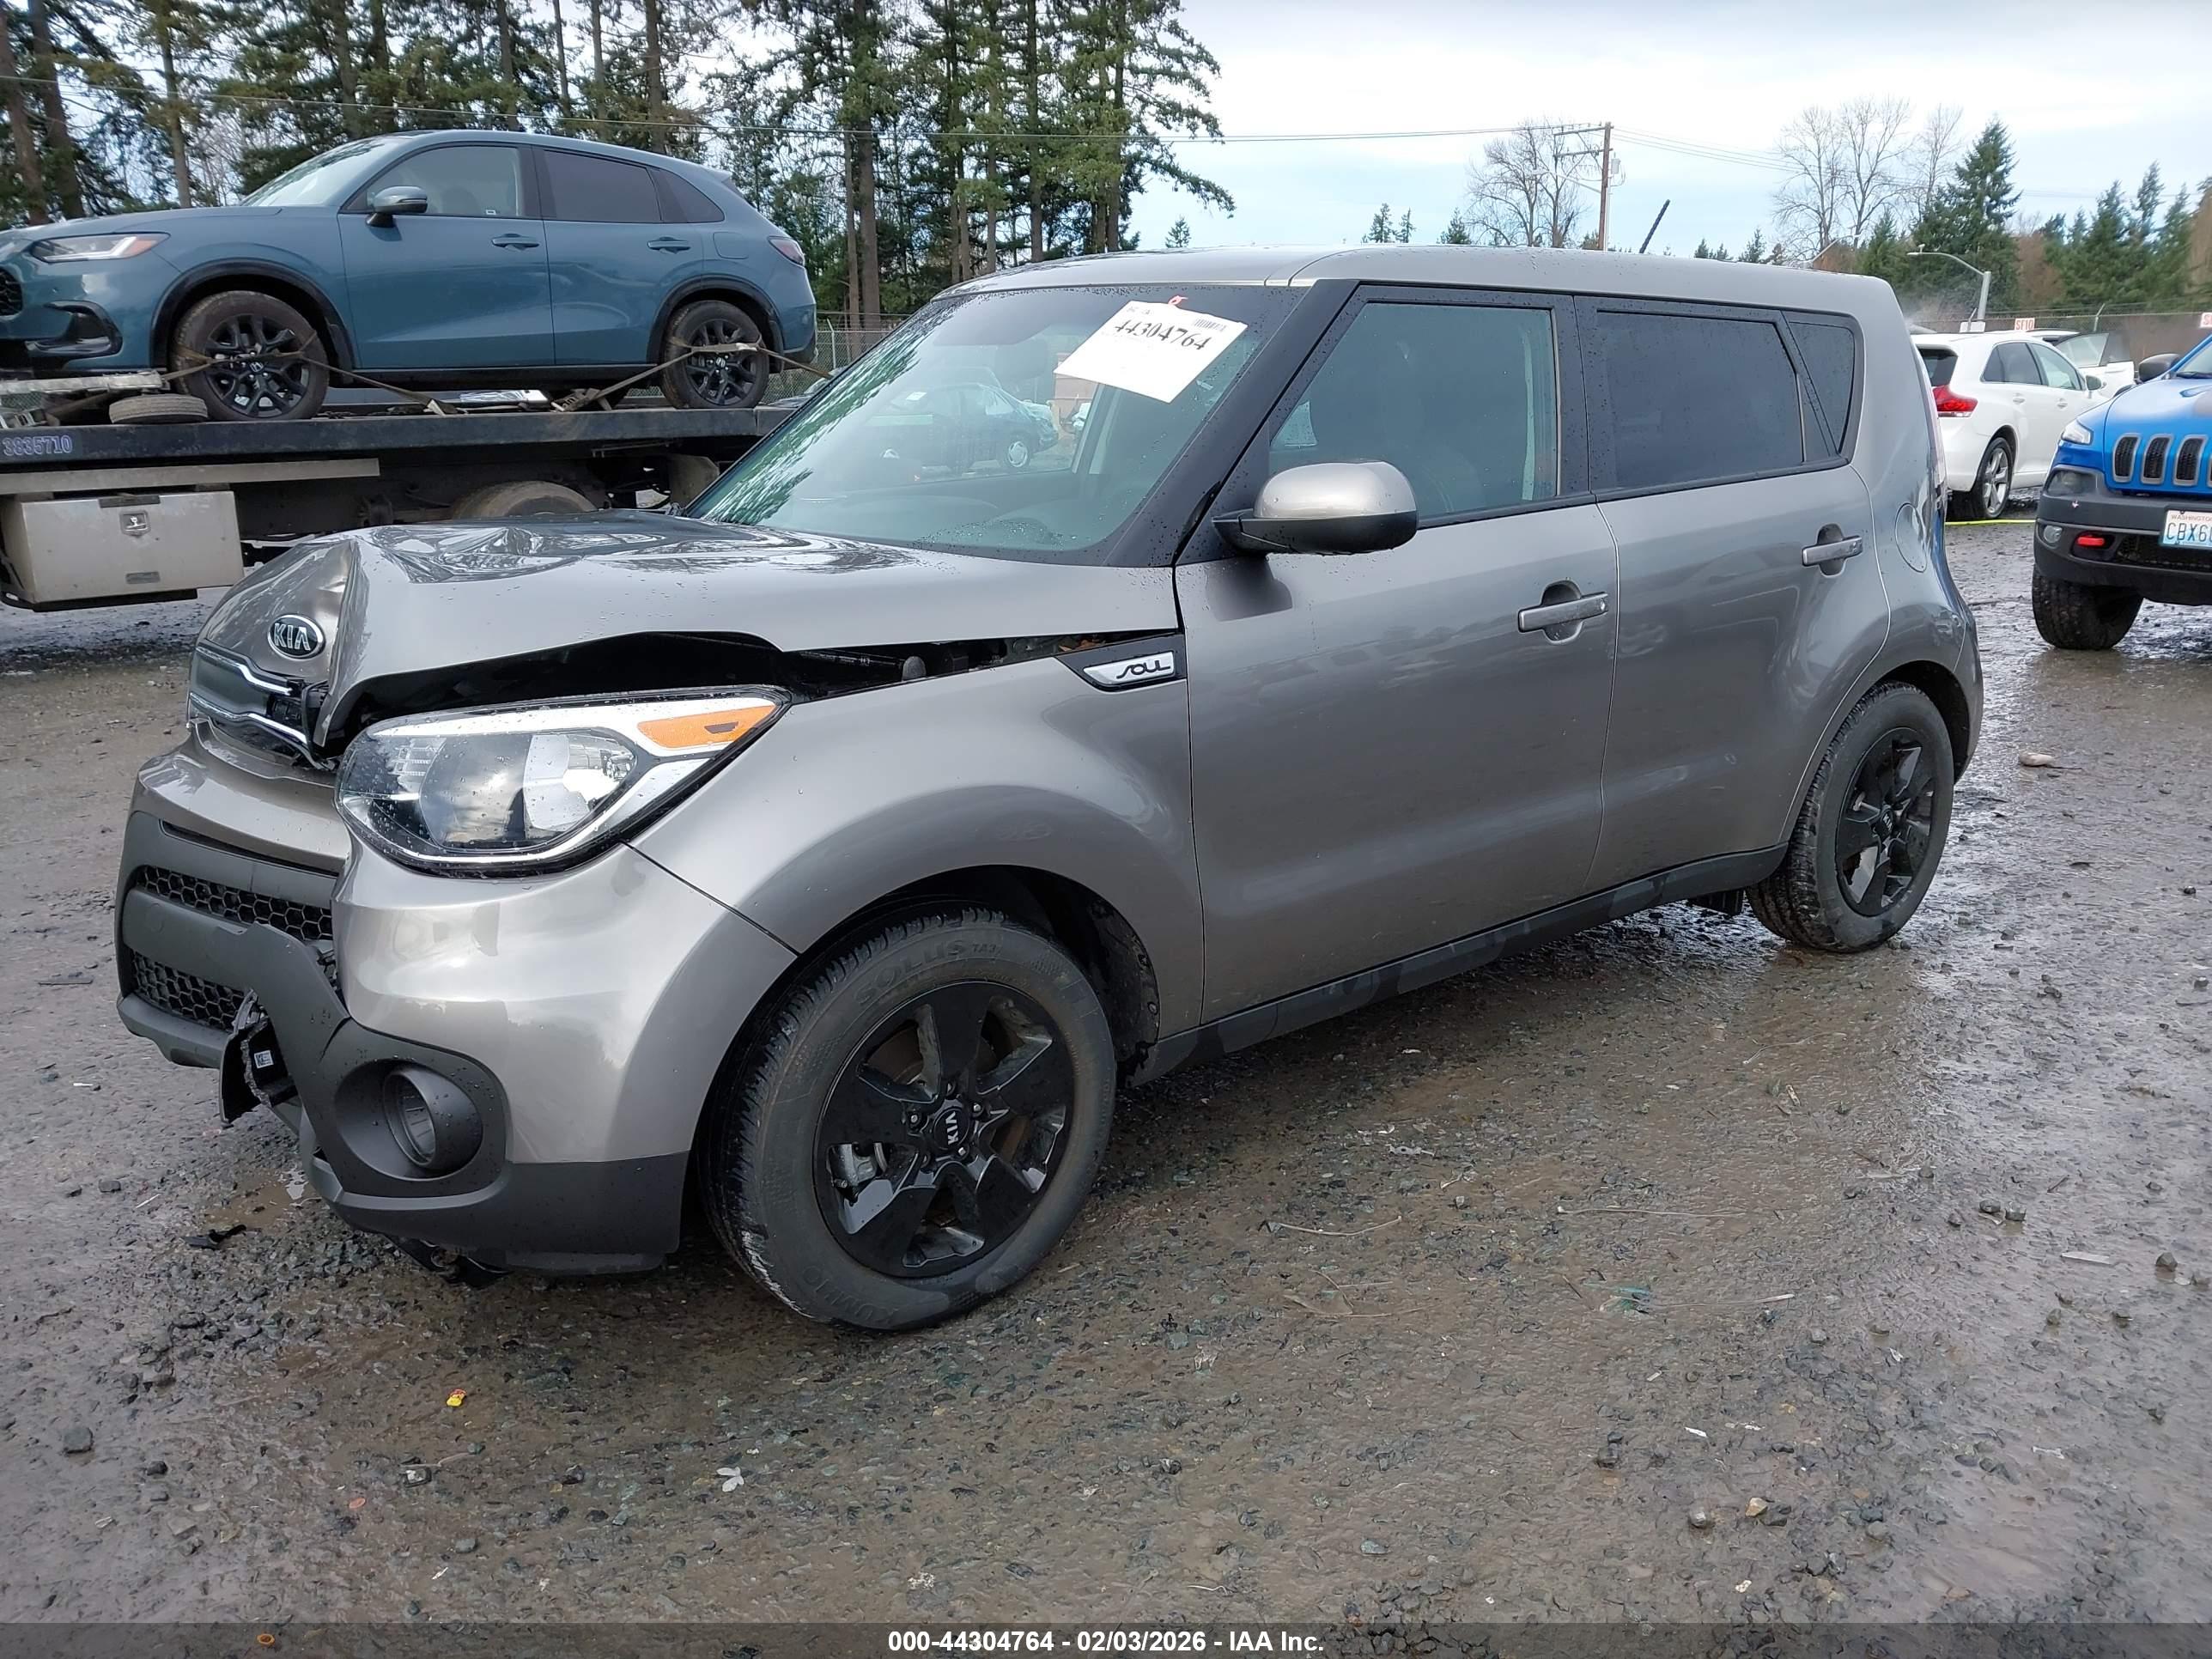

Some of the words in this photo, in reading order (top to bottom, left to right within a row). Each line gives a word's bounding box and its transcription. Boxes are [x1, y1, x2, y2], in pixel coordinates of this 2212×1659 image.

[1115, 319, 1212, 350] 44304764
[2, 434, 73, 456] 3835710
[273, 623, 312, 651] KIA
[1115, 659, 1171, 679] SOUL
[945, 1111, 959, 1146] KIA
